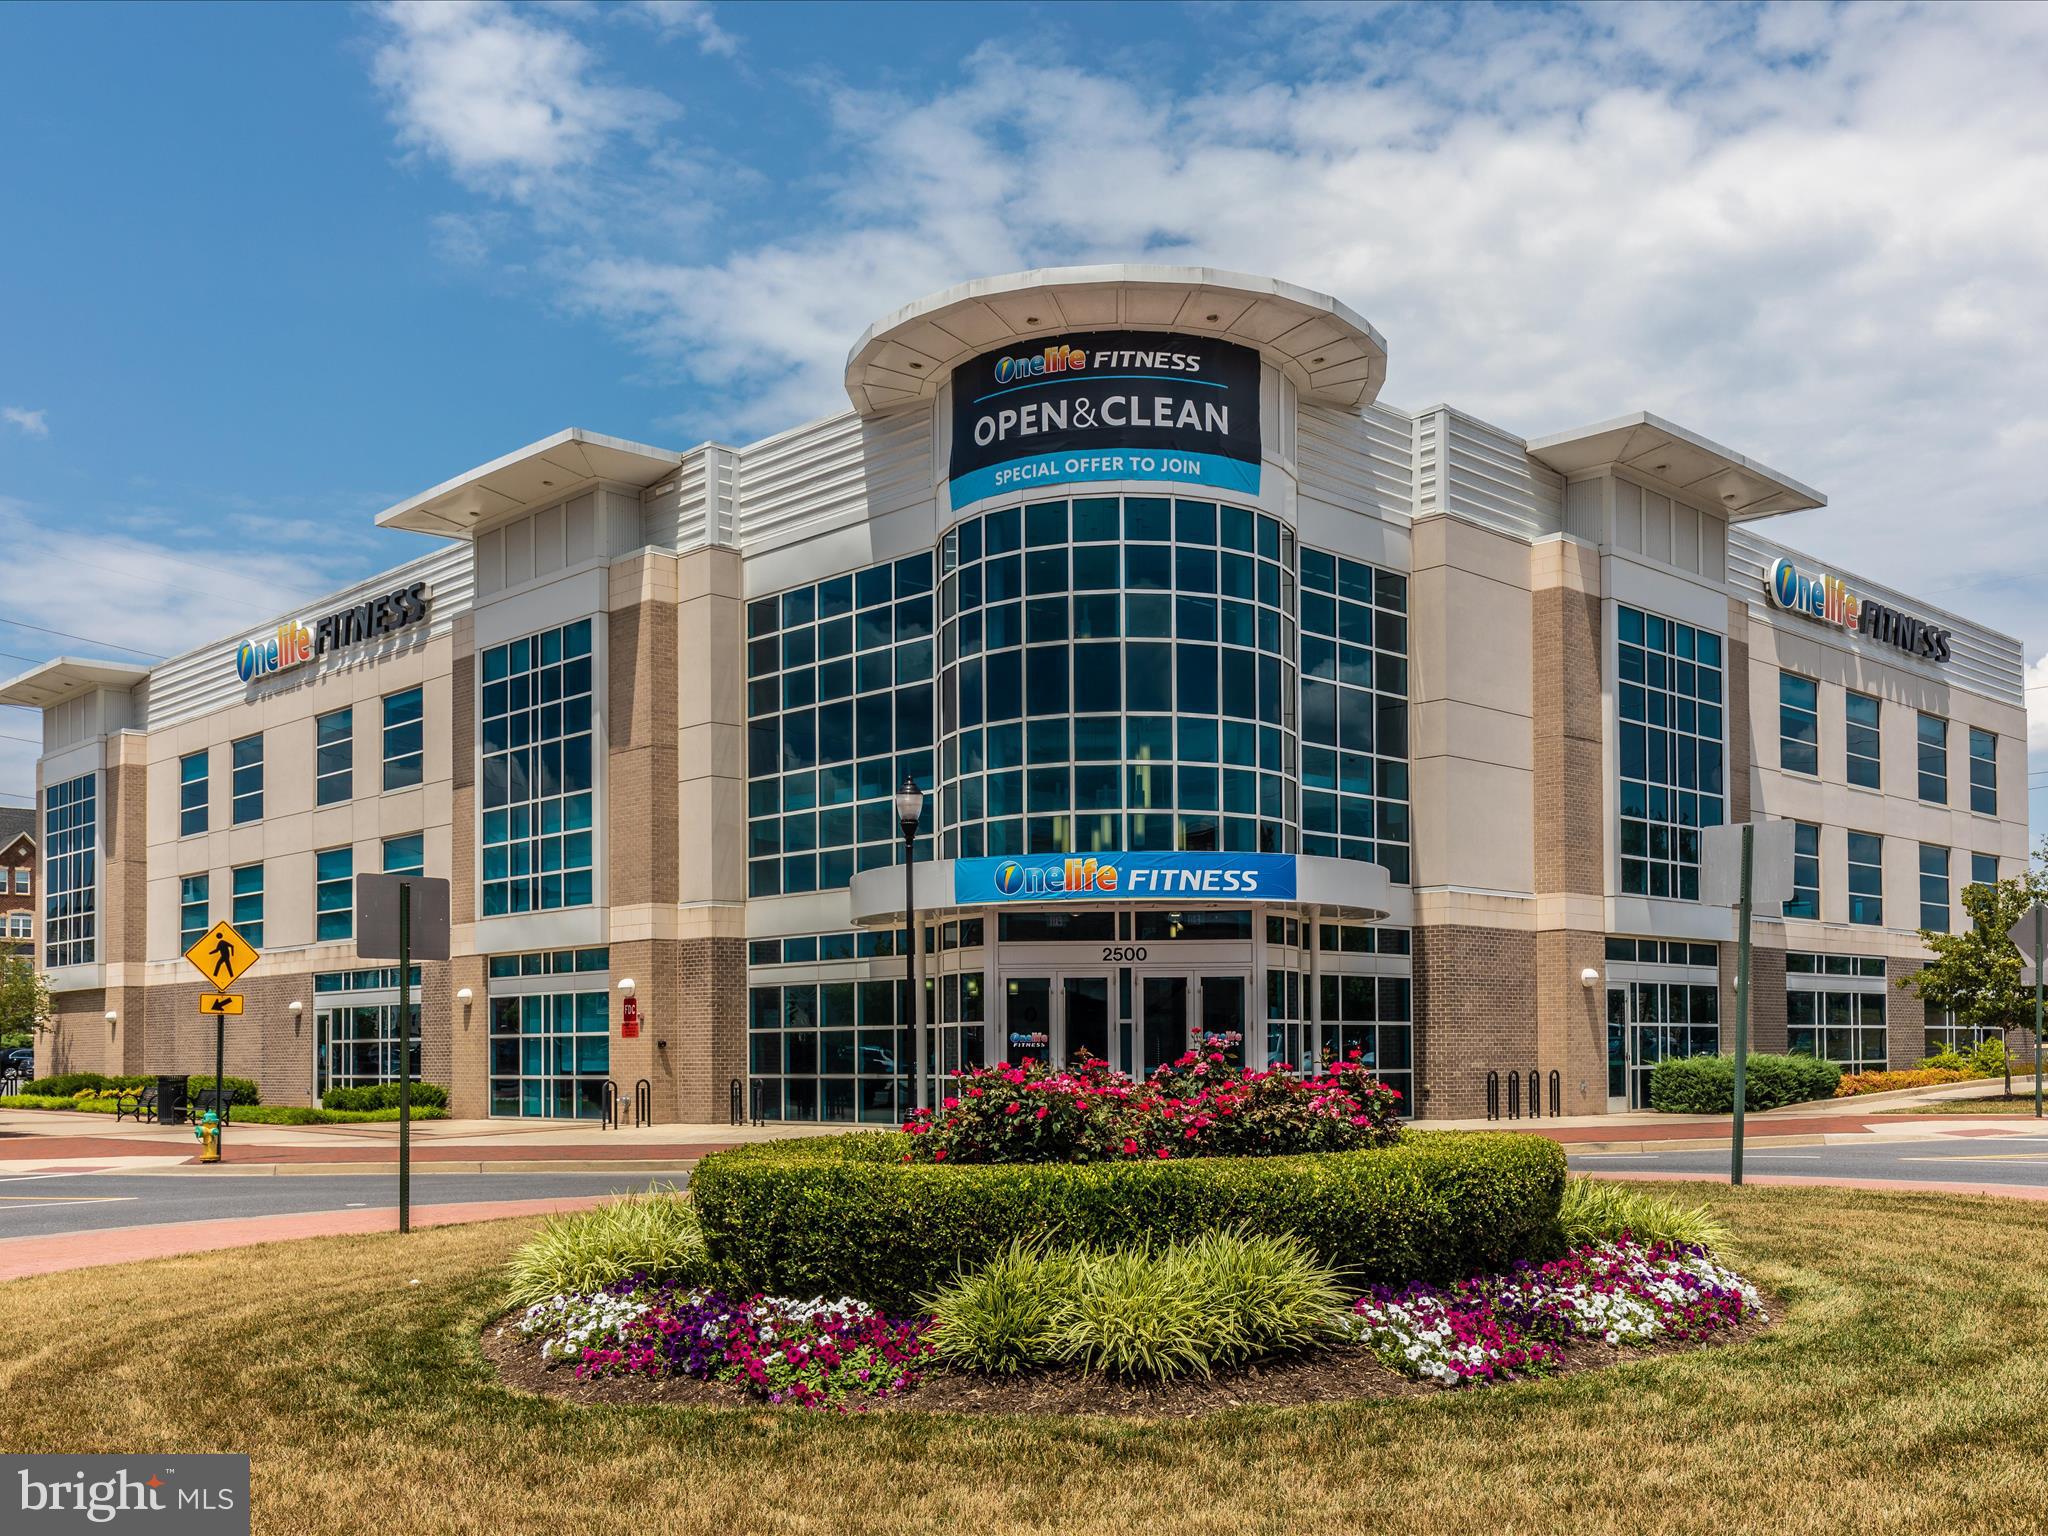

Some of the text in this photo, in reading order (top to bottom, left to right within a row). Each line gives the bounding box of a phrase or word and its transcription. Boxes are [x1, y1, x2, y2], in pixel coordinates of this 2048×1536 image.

[994, 344, 1201, 384] Onelife FITNESS
[973, 395, 1229, 447] OPEN&CLEAN
[995, 456, 1201, 486] SPECIAL OFFER TO JOIN
[1769, 556, 1952, 663] Onelife FITNESS
[235, 581, 427, 685] Onelife FITNESS
[994, 857, 1259, 896] Onelife FITNESS
[1102, 947, 1148, 962] 2500
[624, 1004, 636, 1015] FDC
